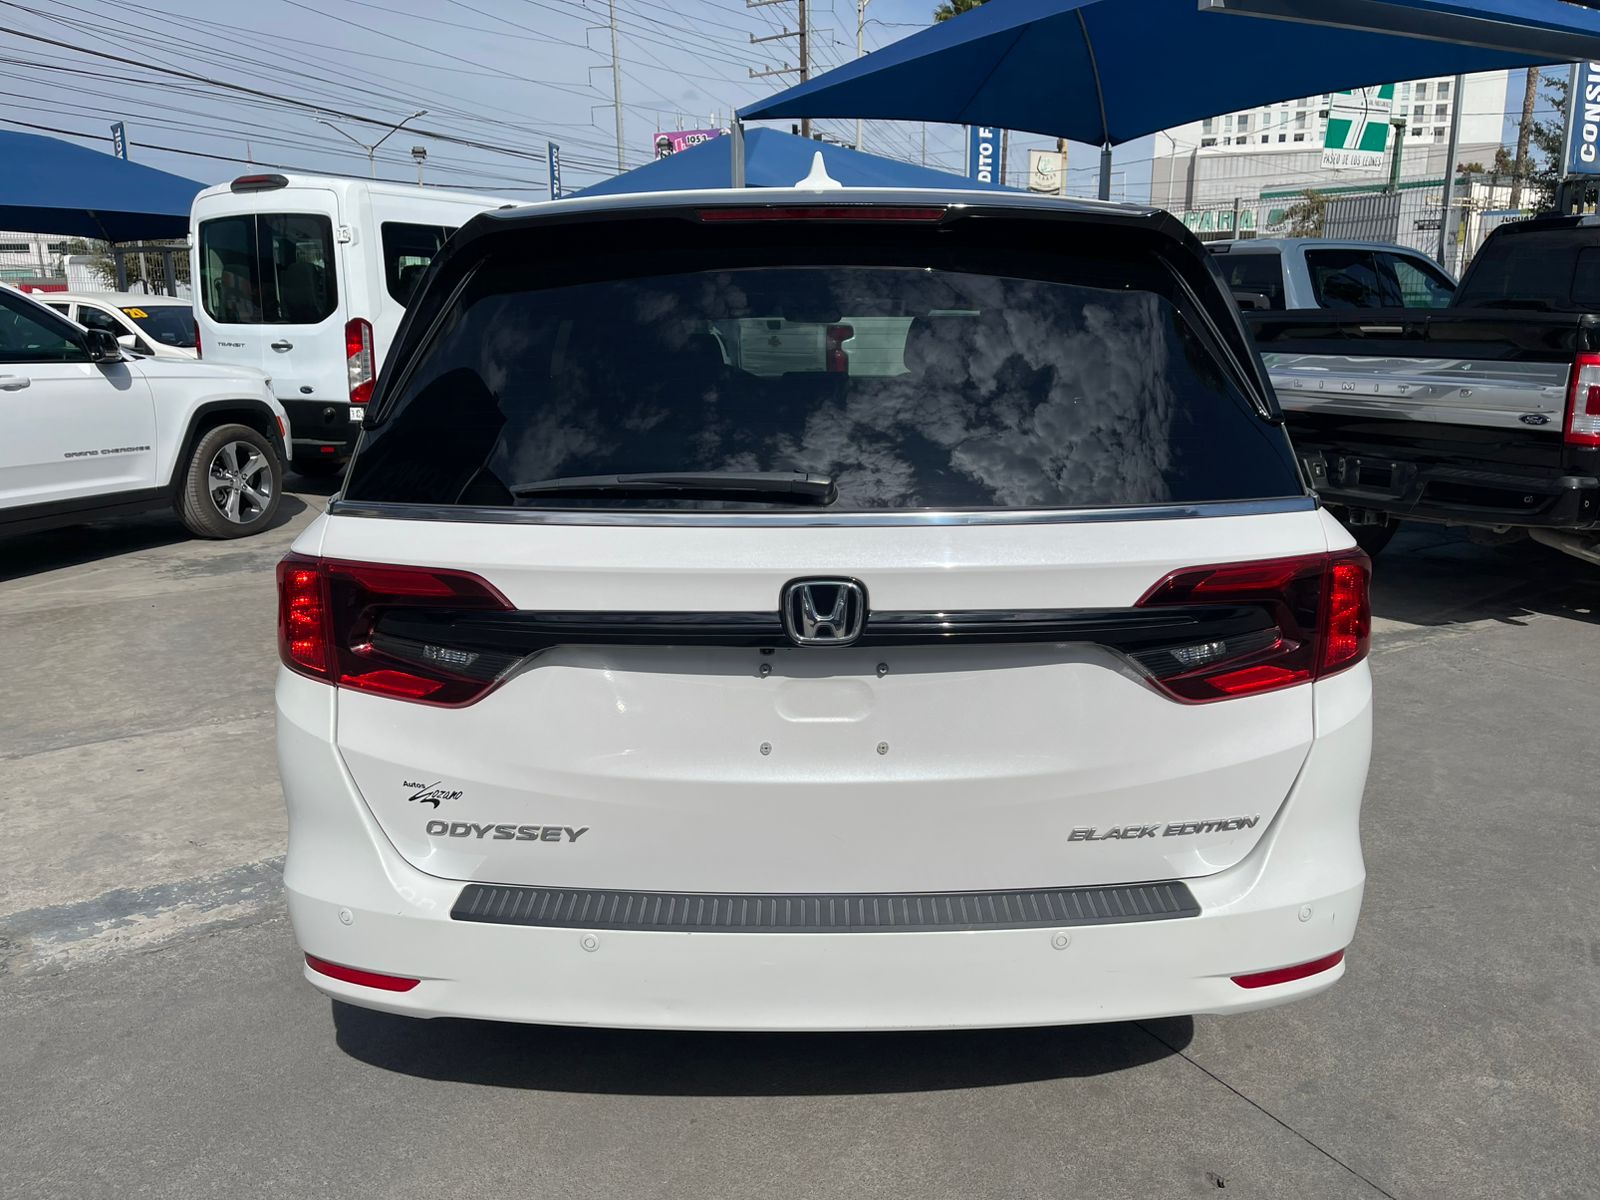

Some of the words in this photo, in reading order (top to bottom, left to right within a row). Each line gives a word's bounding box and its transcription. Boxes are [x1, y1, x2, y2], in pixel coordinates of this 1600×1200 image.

[978, 126, 993, 138] F
[1351, 155, 1361, 166] LOS
[64, 450, 98, 459] GRAND
[101, 445, 151, 455] CHEROKEE
[403, 780, 426, 789] Autos
[426, 820, 590, 843] ODYSSEY
[1067, 824, 1161, 842] BLACK
[1162, 813, 1261, 837] EDITION
